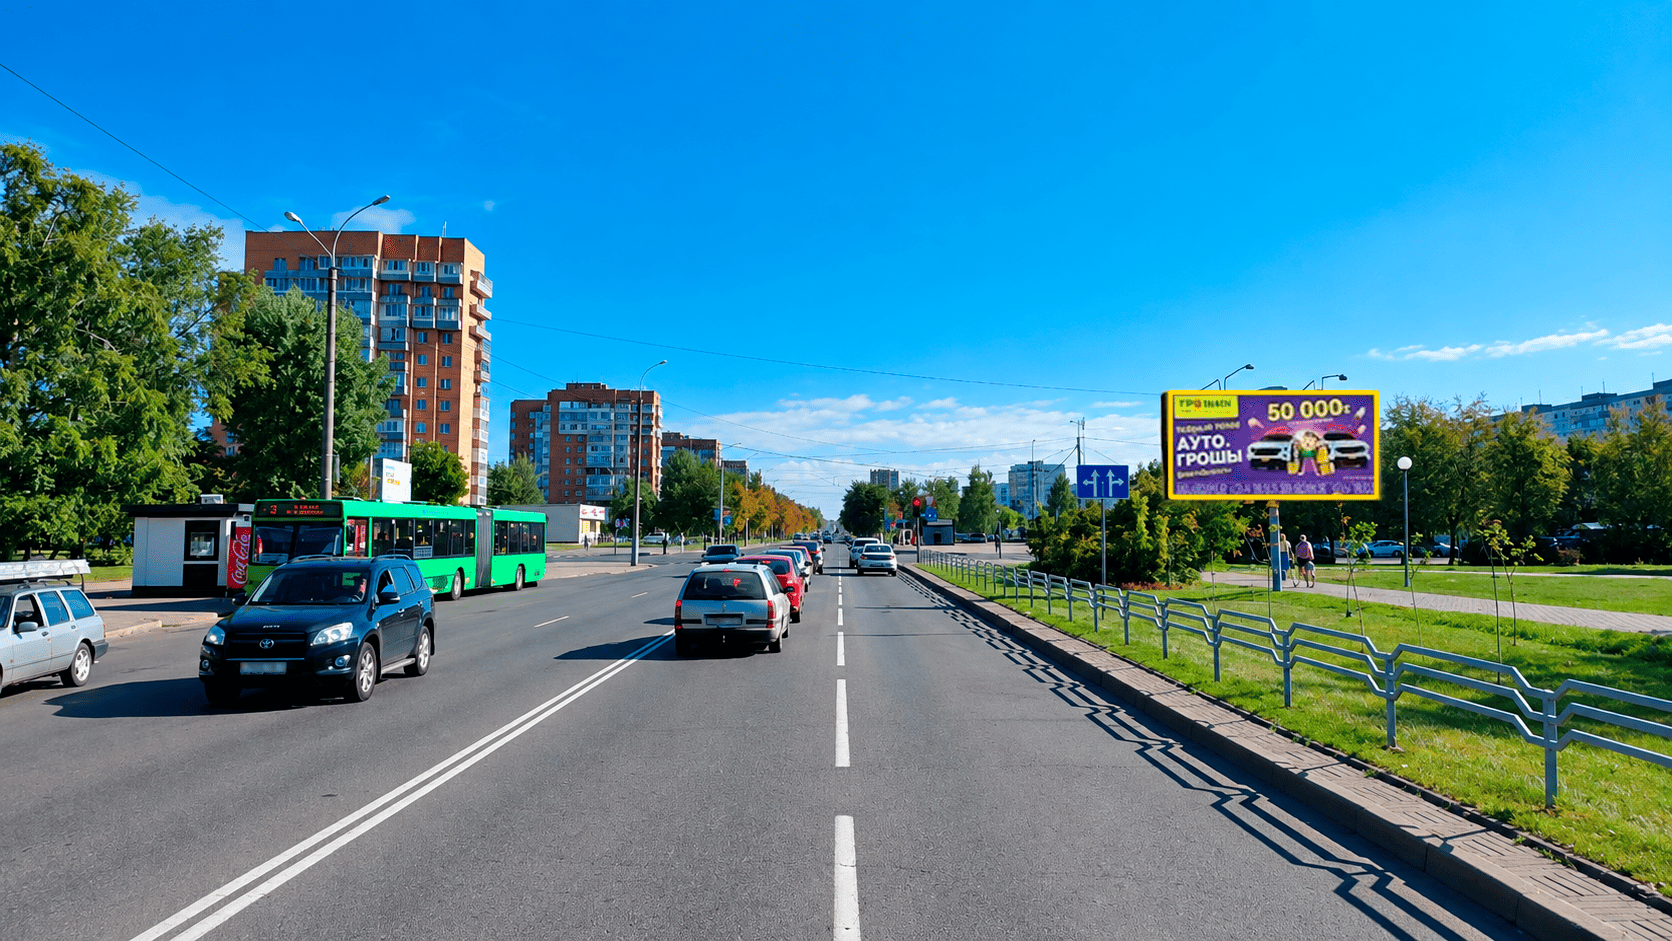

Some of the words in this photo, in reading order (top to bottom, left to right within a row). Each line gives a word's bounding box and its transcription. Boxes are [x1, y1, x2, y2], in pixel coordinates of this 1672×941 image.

[1267, 401, 1295, 422] 50
[1177, 434, 1231, 451] АУТО.
[1177, 450, 1243, 467] ГРОШЫ
[270, 504, 277, 515] 3
